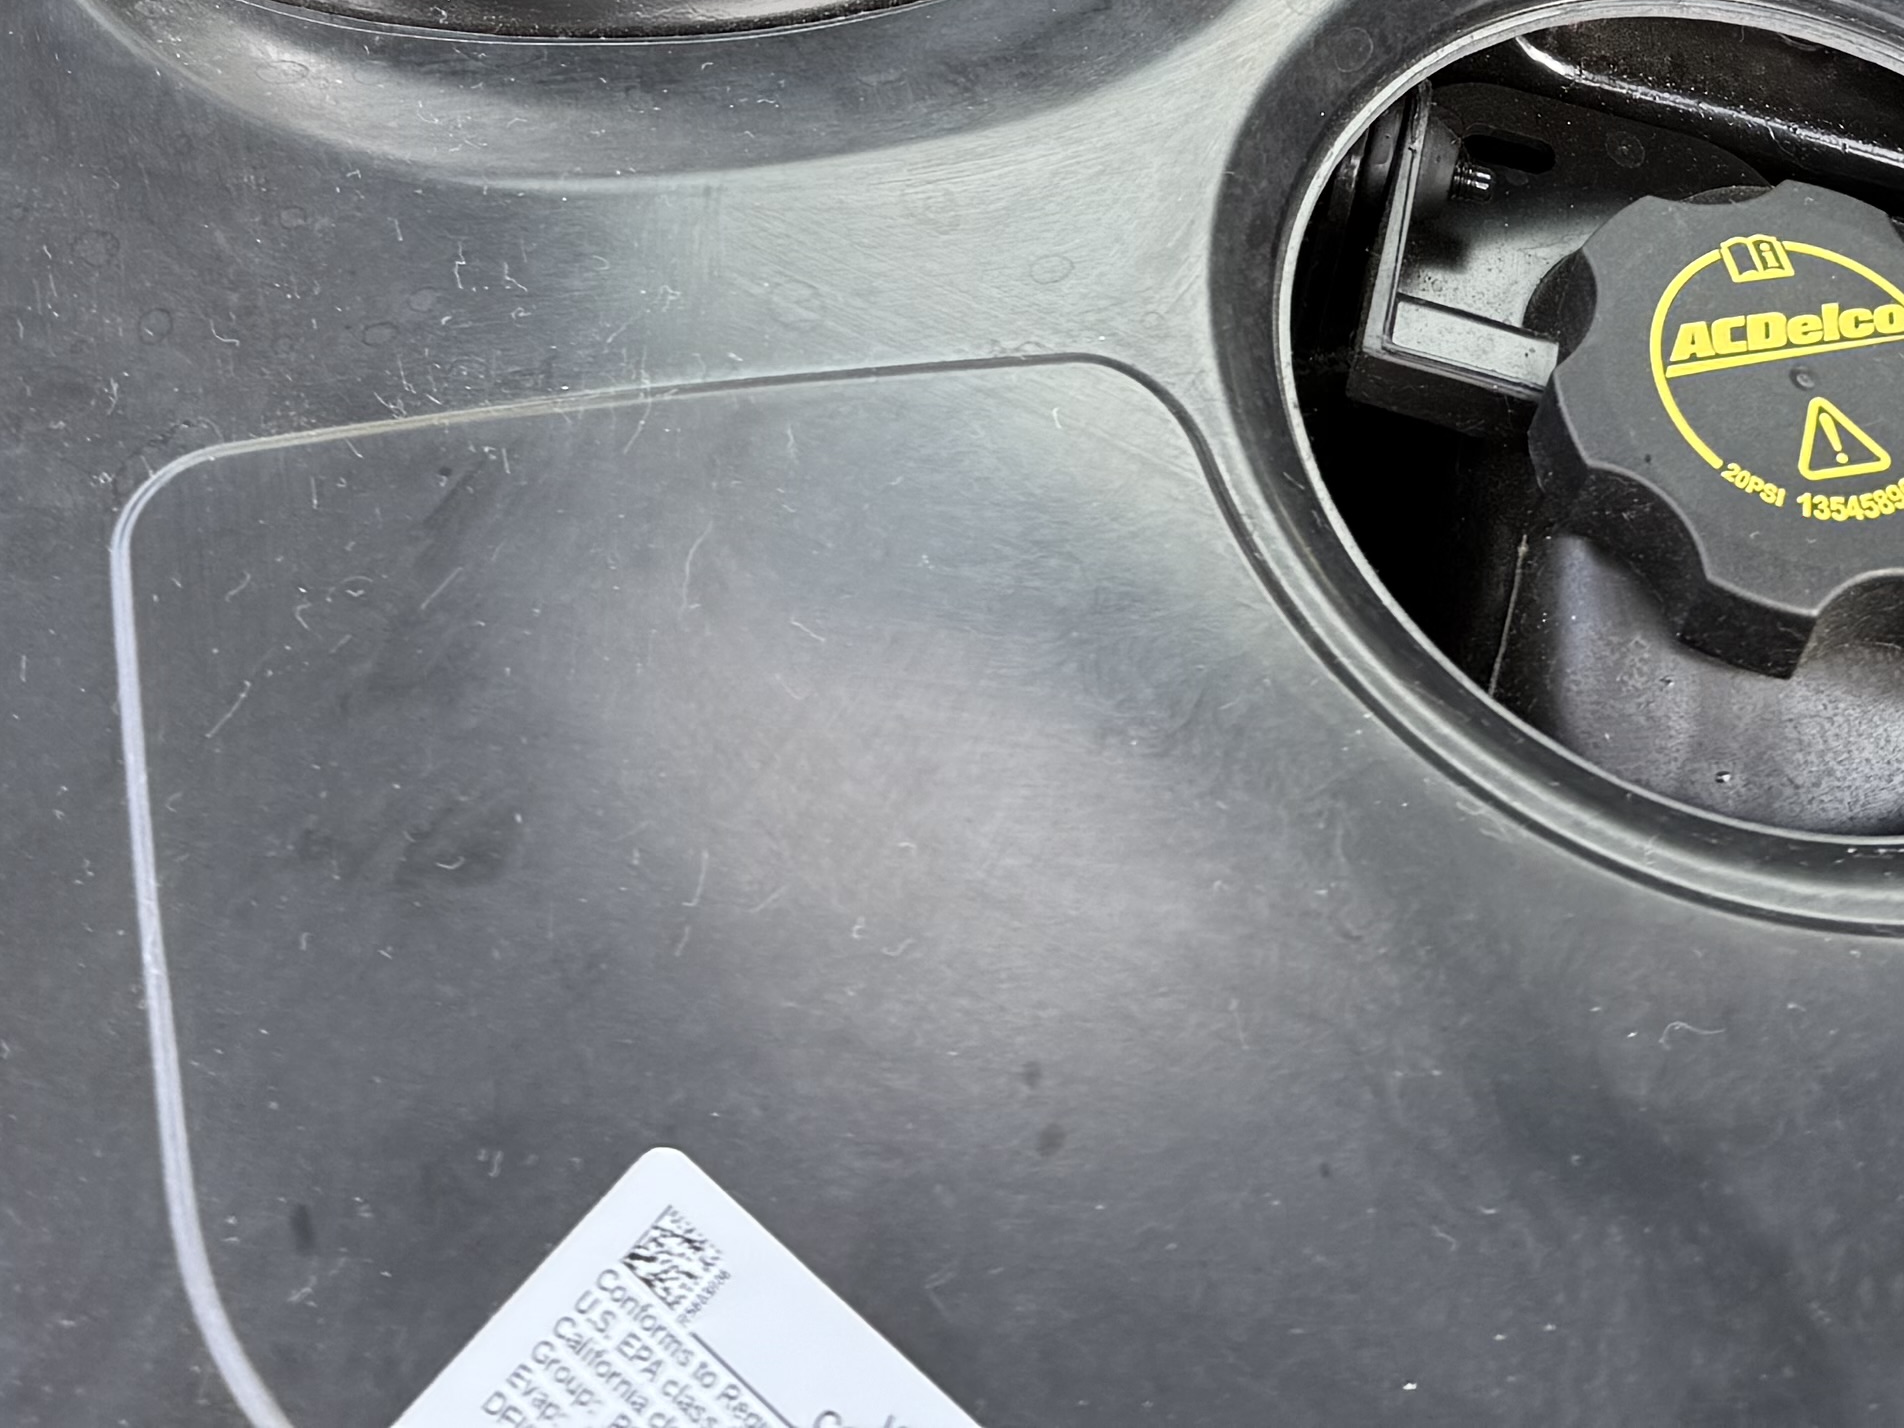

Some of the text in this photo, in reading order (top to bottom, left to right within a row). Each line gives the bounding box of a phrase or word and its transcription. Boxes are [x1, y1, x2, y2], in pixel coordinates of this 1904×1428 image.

[1720, 462, 1788, 508] 20PSI
[554, 1316, 650, 1416] California
[574, 1289, 617, 1341] U.S.
[616, 1331, 664, 1383] EPA
[596, 1268, 695, 1368] Conforms
[692, 1360, 718, 1389] to
